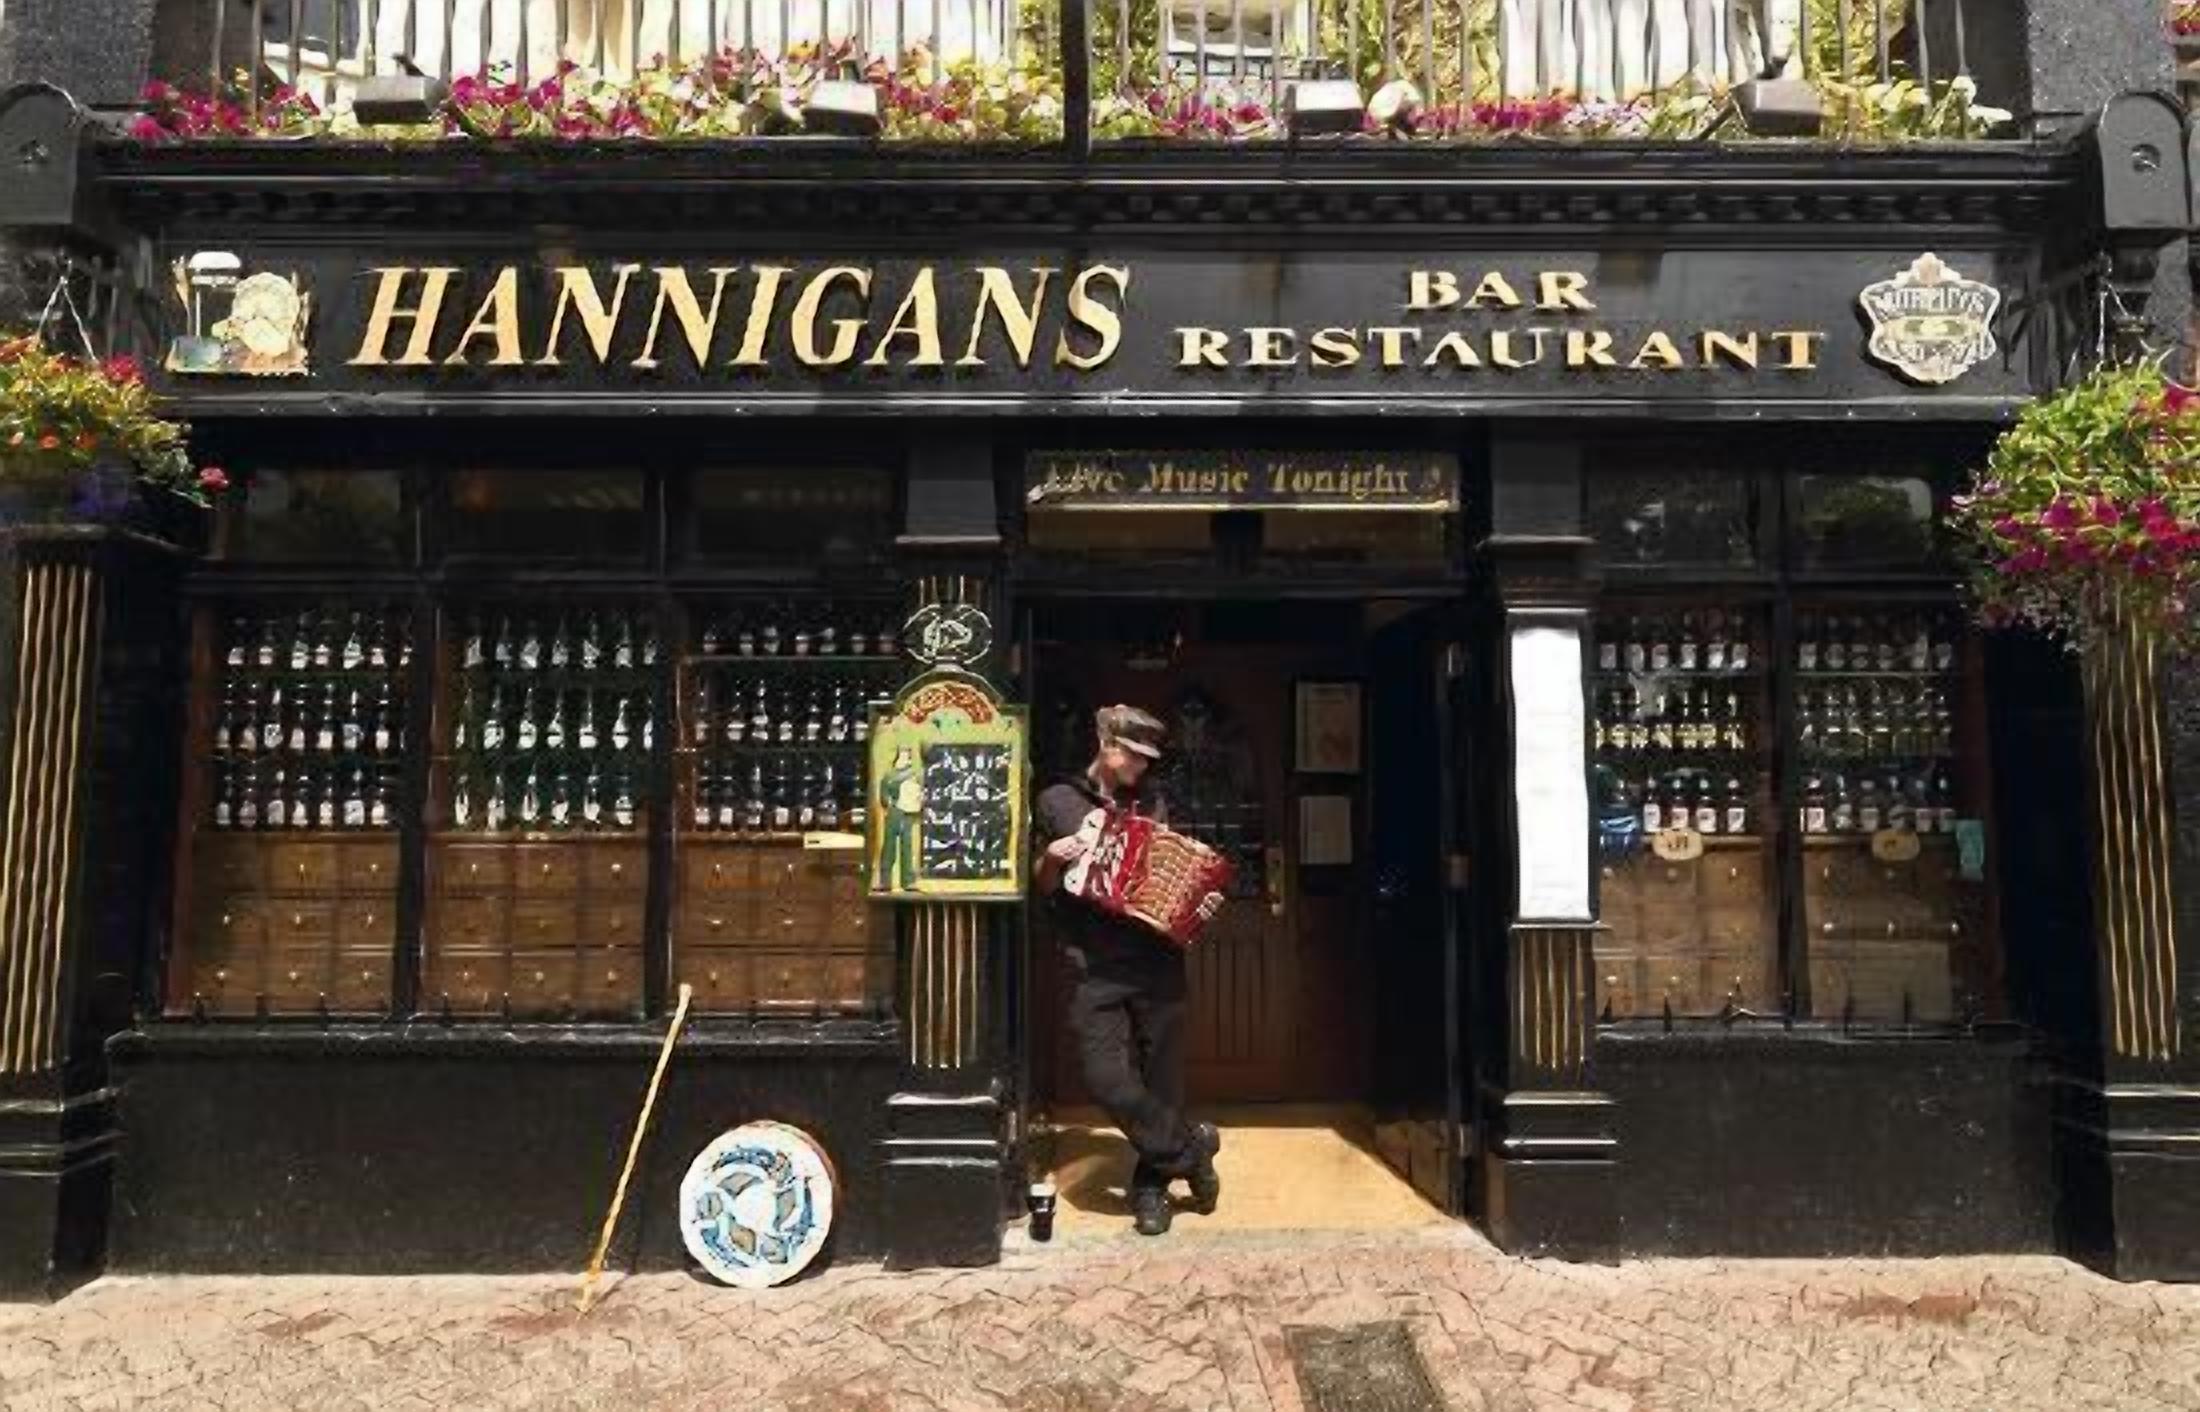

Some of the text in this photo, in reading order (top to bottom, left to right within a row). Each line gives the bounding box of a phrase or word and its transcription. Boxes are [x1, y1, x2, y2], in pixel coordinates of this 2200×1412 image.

[1406, 269, 1597, 313] BAR
[344, 262, 1130, 371] HANNIGANS
[1176, 326, 1826, 372] RESTAURANT
[1139, 462, 1249, 495] Music
[1267, 462, 1409, 500] Tonight
